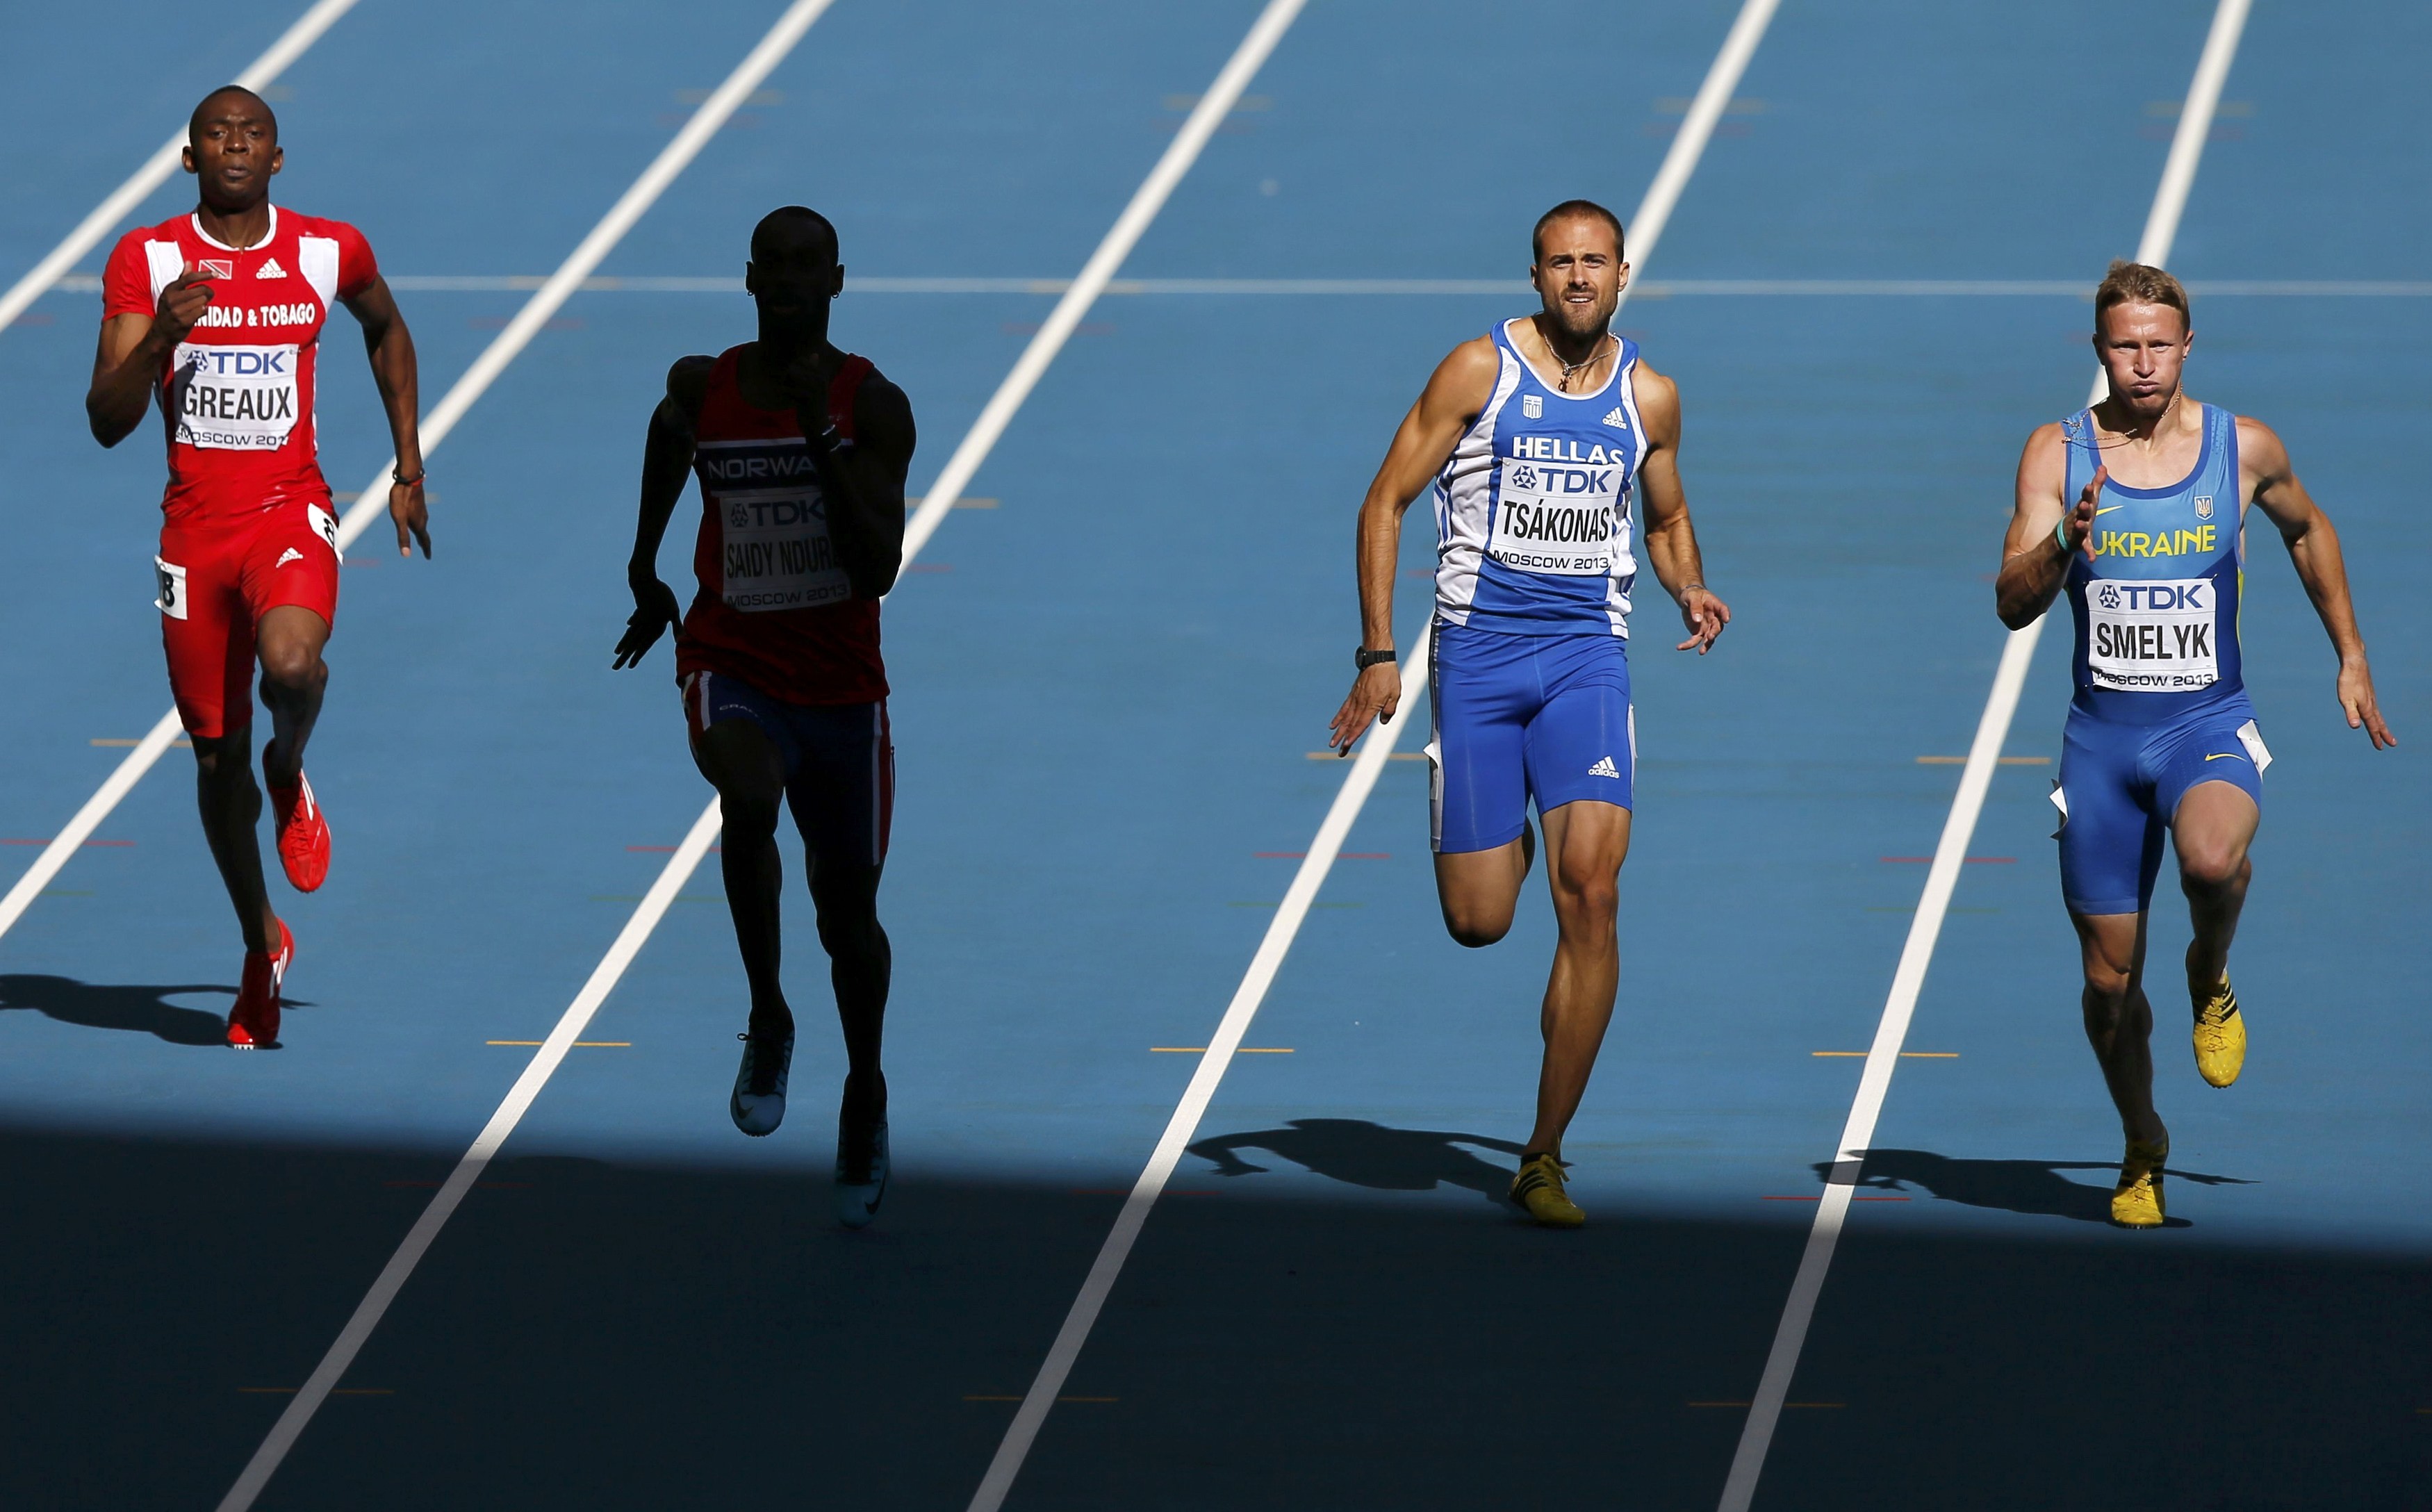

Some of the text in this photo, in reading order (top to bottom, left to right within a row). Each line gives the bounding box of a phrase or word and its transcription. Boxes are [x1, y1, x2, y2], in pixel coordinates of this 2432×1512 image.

[256, 270, 288, 280] adidas
[194, 303, 315, 328] NIDAD & TOBAGO
[208, 350, 286, 375] TDK
[182, 383, 293, 421] GREAUX
[1602, 418, 1627, 429] adidas
[256, 435, 286, 445] 20
[1513, 436, 1625, 465] HELLAS
[707, 456, 816, 480] NORWA
[1536, 468, 1613, 494] TDK
[748, 496, 826, 527] TDK
[1502, 498, 1611, 543] TSÁKONAS
[2094, 525, 2217, 558] UKRAINE
[727, 535, 834, 580] SAIDY NDUR
[1493, 549, 1610, 570] MOSCOW 2013
[728, 584, 848, 608] MOSCOW 2013
[2120, 584, 2203, 611] TDK
[2096, 622, 2211, 660] SMELYK
[2173, 673, 2214, 687] 2013
[1588, 766, 1620, 779] adidas
